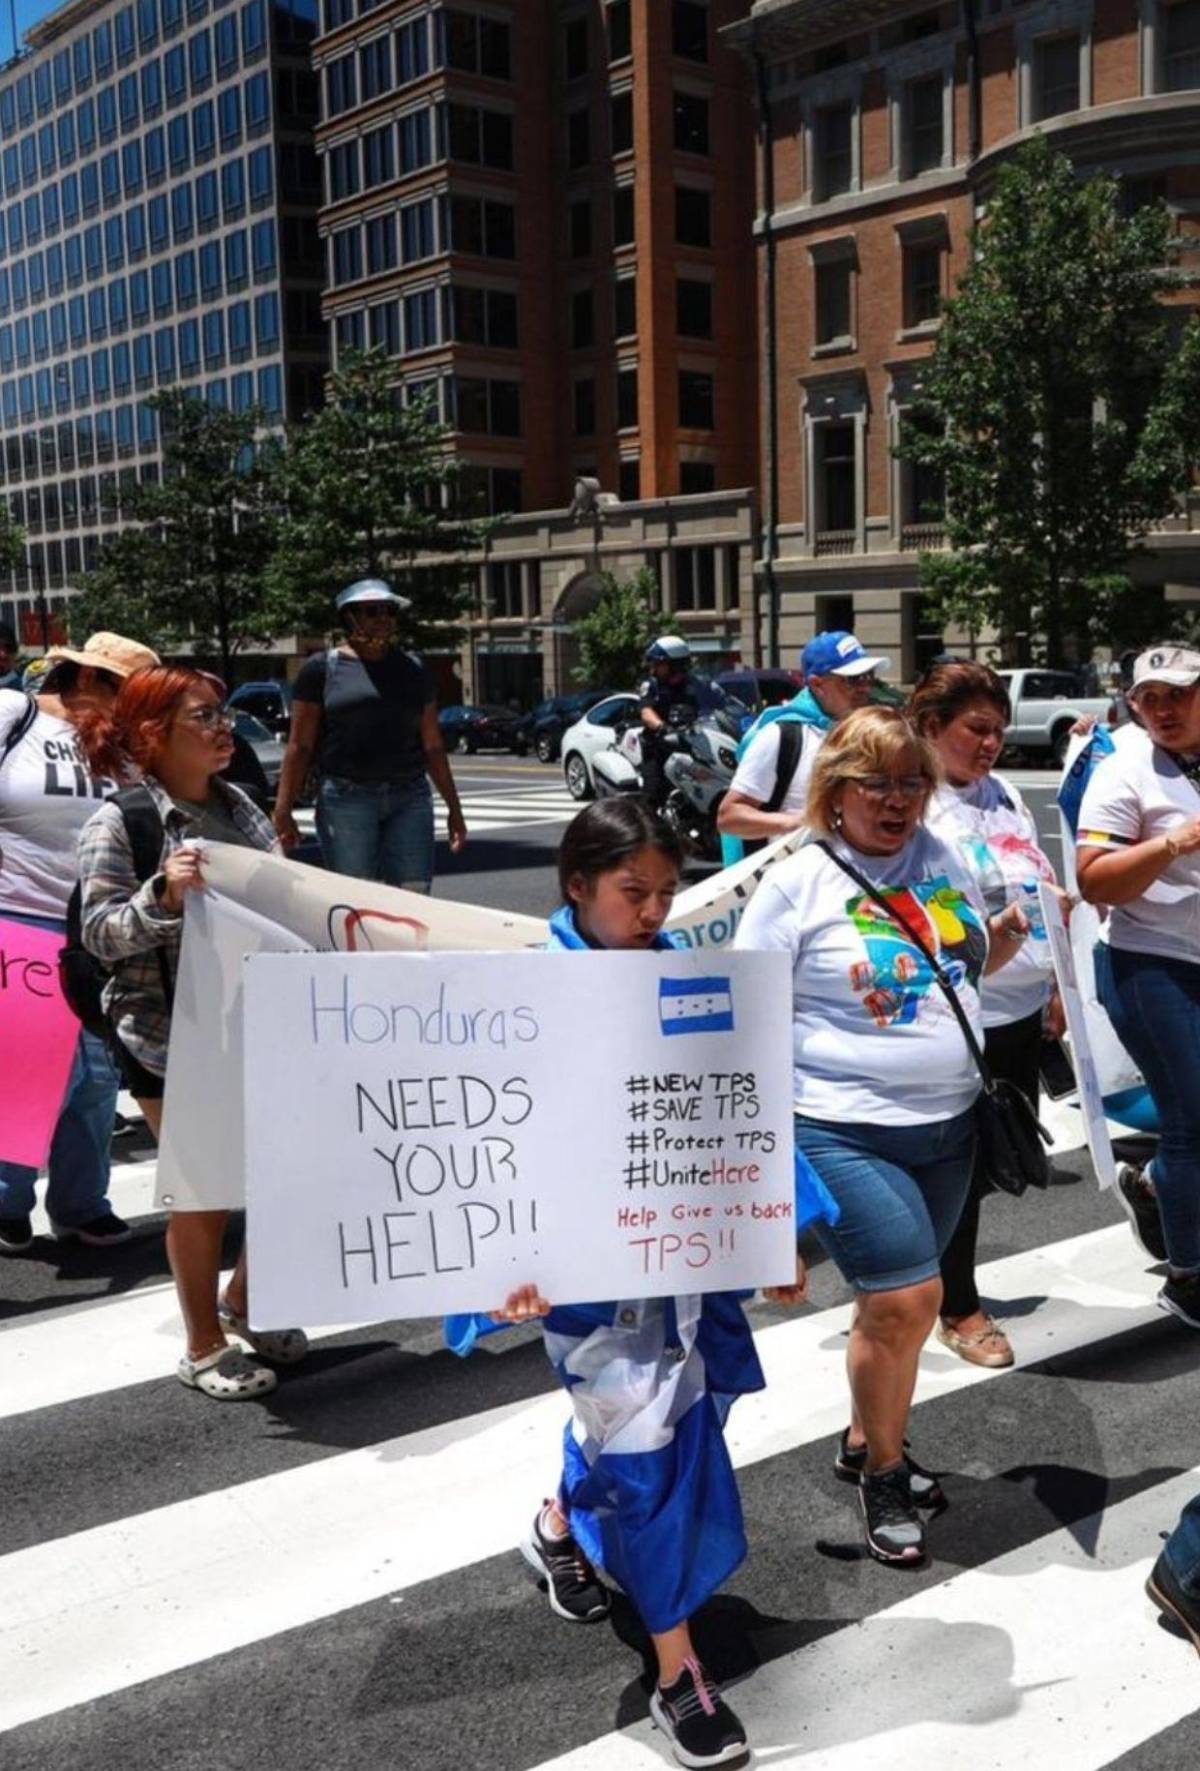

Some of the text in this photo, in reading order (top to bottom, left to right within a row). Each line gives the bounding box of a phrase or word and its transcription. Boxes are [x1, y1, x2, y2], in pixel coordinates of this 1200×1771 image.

[0, 949, 54, 997] re
[311, 974, 540, 1048] Honduras
[356, 1075, 533, 1133] NEEDS
[625, 1072, 756, 1094] #NEW TPS
[627, 1092, 761, 1122] #SAVE TPS
[626, 1127, 776, 1154] #Protect TPS
[374, 1137, 517, 1202] YOUR
[618, 1202, 792, 1228] Help Give us back
[337, 1200, 540, 1289] HELP!!
[628, 1229, 735, 1274] TPS!!
